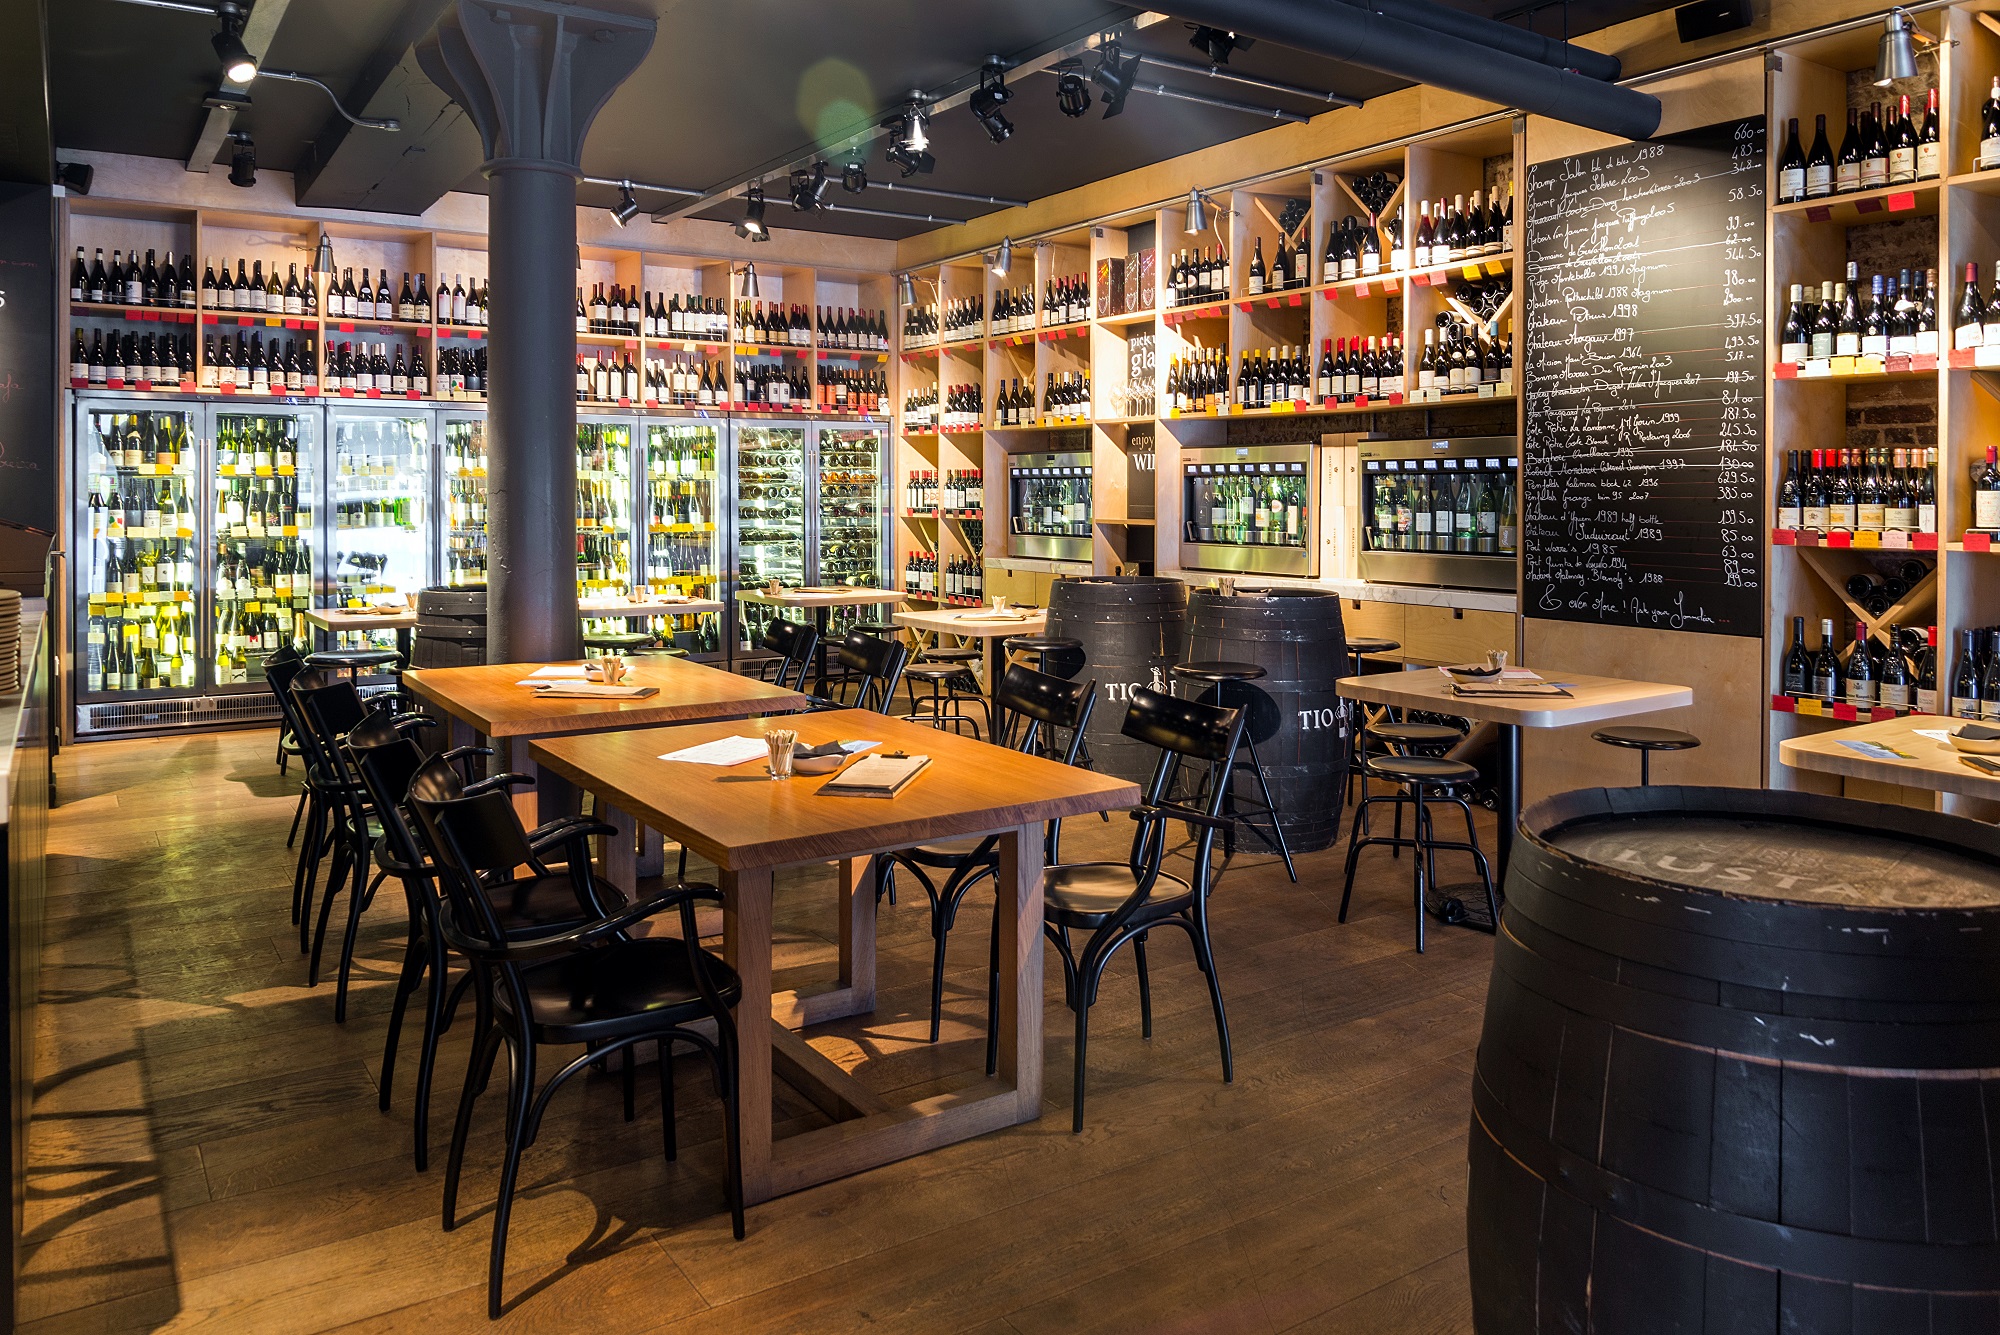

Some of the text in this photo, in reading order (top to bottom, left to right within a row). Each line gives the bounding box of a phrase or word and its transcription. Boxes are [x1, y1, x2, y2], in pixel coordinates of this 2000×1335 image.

[1632, 144, 1665, 163] 1988
[1561, 182, 1588, 208] Jacques
[1621, 165, 1650, 186] 2003
[1728, 183, 1763, 202] 58.50
[1526, 250, 1565, 265] Domaine
[1568, 245, 1576, 257] de
[1527, 274, 1550, 293] Ridge
[1599, 265, 1625, 276] 1991
[1724, 245, 1762, 260] 544.50
[1604, 285, 1629, 299] 1988
[1607, 304, 1638, 318] 1998
[1608, 328, 1635, 342] 1997
[1724, 312, 1762, 329] 397.50
[1130, 331, 1152, 352] pick
[1618, 345, 1642, 359] 1964
[1724, 334, 1760, 349] 493.50
[1130, 346, 1156, 378] gla
[1650, 354, 1673, 369] 2003
[1721, 388, 1753, 405] 81.00
[1656, 412, 1680, 425] 1999
[1720, 406, 1756, 420] 187.50
[1719, 422, 1757, 437] 245.50
[1131, 432, 1155, 452] enjoy
[1717, 438, 1758, 453] 184.50
[1658, 457, 1686, 470] 1997
[1638, 477, 1660, 487] 1996
[1717, 470, 1755, 484] 629.50
[1612, 490, 1623, 502] 95
[1628, 490, 1650, 501] 2007
[1717, 486, 1753, 499] 385.00
[1594, 510, 1618, 523] 1989
[1621, 512, 1636, 532] half
[1717, 509, 1754, 524] 199.50
[1634, 527, 1663, 541] 1989
[1720, 528, 1754, 543] 85.00
[1582, 542, 1618, 554] 1985
[1721, 545, 1754, 558] 63.00
[1723, 558, 1756, 575] 89.00
[1723, 573, 1758, 588] 199.00
[1568, 591, 1588, 609] even
[1297, 708, 1334, 730] TIO
[1612, 849, 1942, 906] LUSTAU
